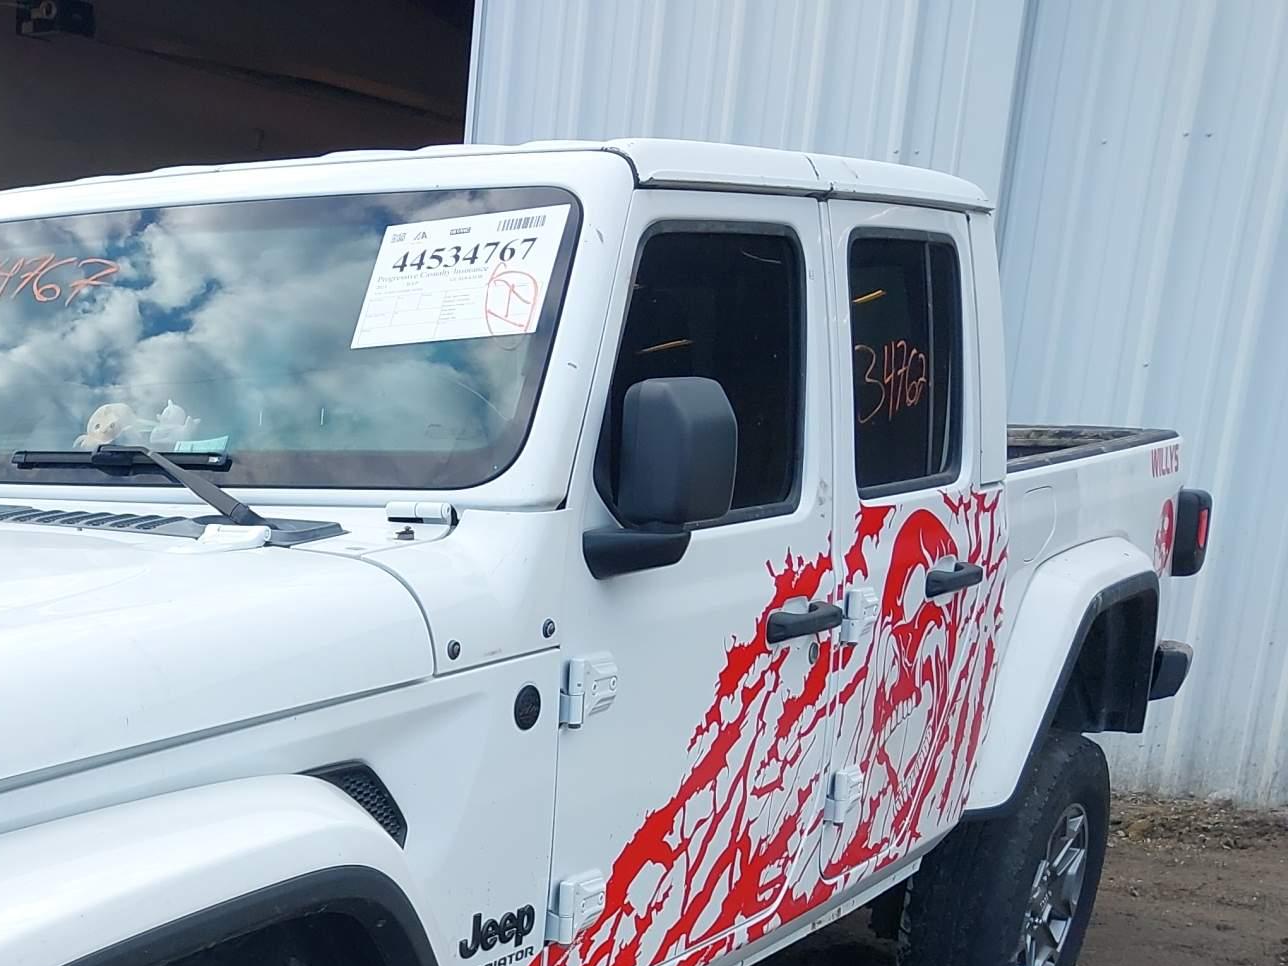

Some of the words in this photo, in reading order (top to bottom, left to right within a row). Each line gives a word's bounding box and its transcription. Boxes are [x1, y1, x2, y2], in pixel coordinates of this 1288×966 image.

[392, 237, 538, 273] 44534767
[1151, 443, 1179, 478] WILLYS
[459, 904, 535, 959] Jeep
